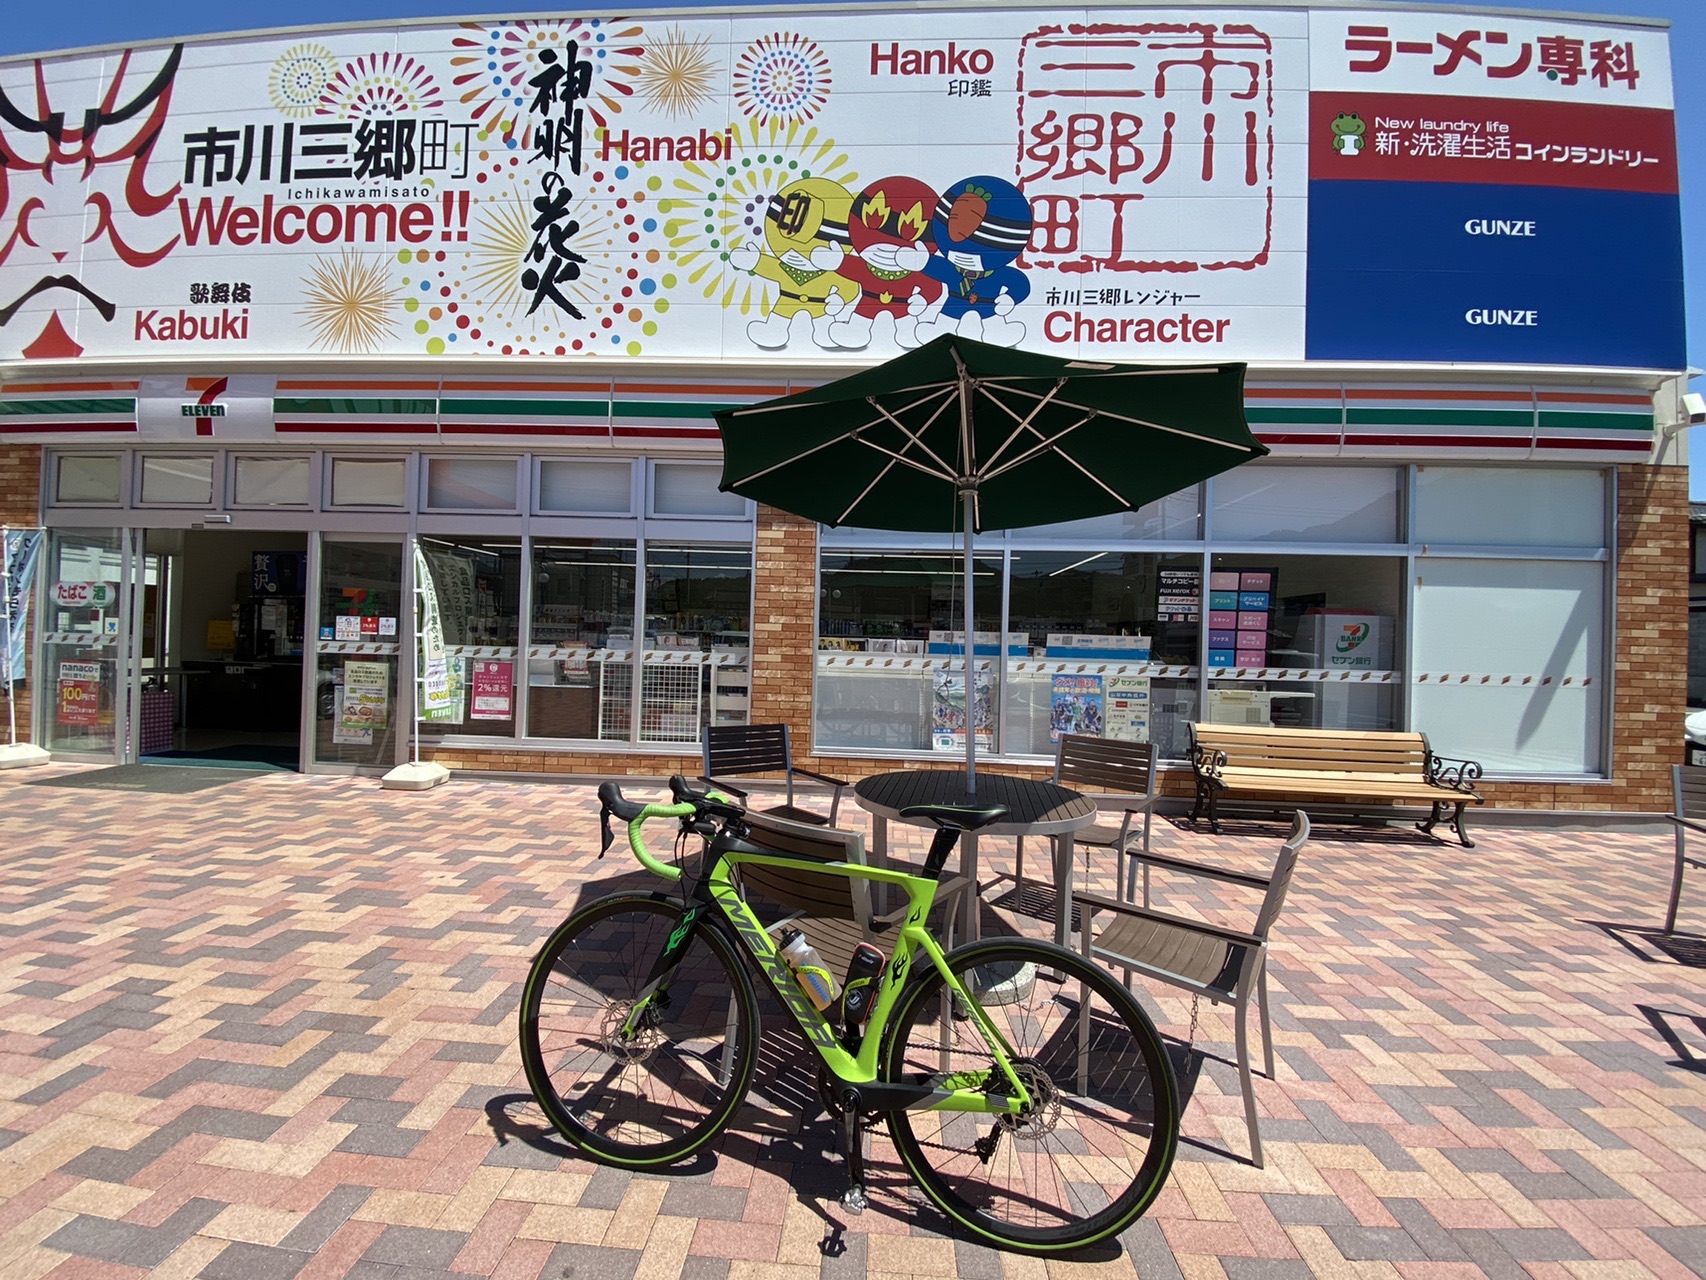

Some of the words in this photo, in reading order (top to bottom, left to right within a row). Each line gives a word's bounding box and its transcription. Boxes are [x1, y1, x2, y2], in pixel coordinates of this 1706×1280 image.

[870, 42, 994, 75] Hanko
[1345, 25, 1639, 90] ラーメン専科
[948, 79, 992, 97] 印鑑
[1375, 116, 1415, 130] New
[1419, 118, 1482, 134] laundry
[1485, 120, 1510, 134] life
[183, 119, 480, 188] 市川三郷町
[601, 128, 733, 162] Hanabi
[1375, 131, 1511, 160] 新・洗濯生活
[1515, 142, 1660, 168] コインランドリー
[287, 186, 430, 200] Ichikawamisato
[521, 39, 593, 320] 神明の花火
[179, 190, 470, 247] Welcome!!
[777, 192, 812, 236] 印
[1464, 219, 1536, 237] GUNZE
[189, 282, 251, 304] 歌舞伎
[1046, 287, 1201, 306] 市川三郷レンジャー
[135, 308, 249, 341] Kabuki
[1043, 310, 1231, 344] Character
[1465, 308, 1538, 327] GUNZE
[57, 585, 88, 600] たばこ
[92, 585, 107, 600] 酒
[1331, 656, 1372, 665] セブン銀行
[717, 898, 837, 1049] MERIDA
[951, 988, 1000, 1051] REACTO
